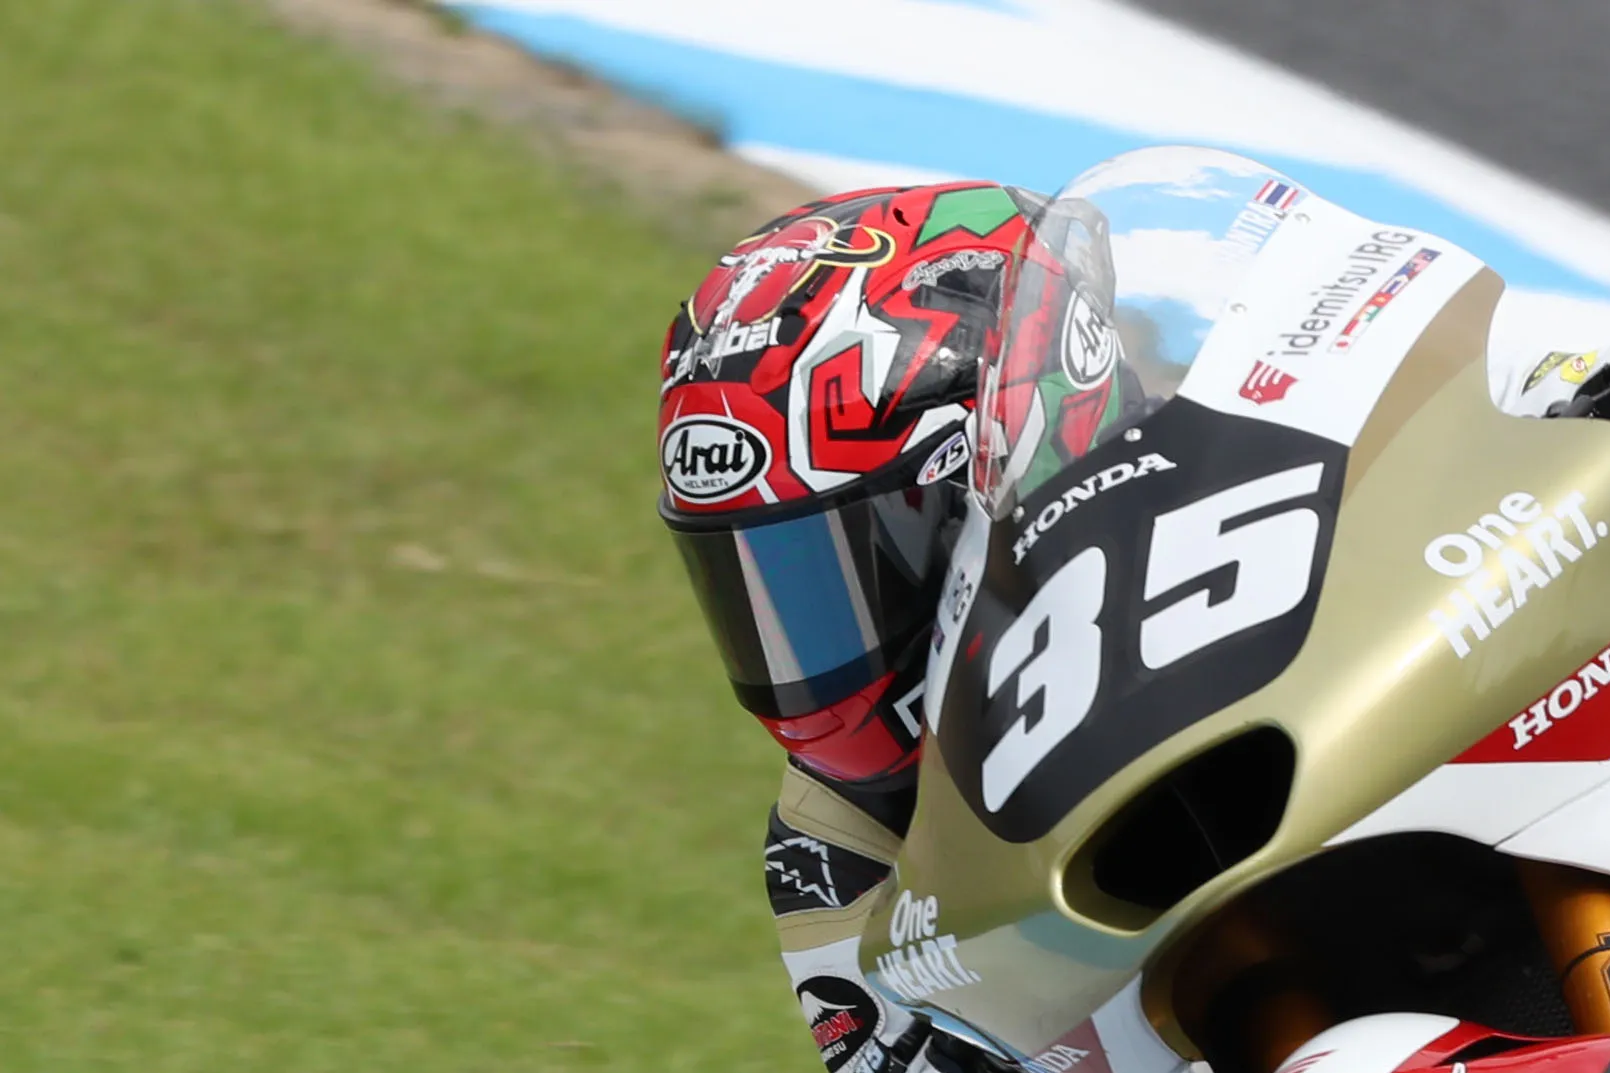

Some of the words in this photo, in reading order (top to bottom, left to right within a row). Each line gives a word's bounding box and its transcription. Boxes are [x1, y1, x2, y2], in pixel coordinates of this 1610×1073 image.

[1267, 262, 1375, 357] idemitsu
[665, 429, 749, 476] Arai
[1012, 452, 1178, 565] HONDA
[1423, 490, 1541, 580] One
[1430, 490, 1609, 660] HEART.
[982, 461, 1325, 813] 35
[890, 889, 939, 948] One
[876, 934, 982, 1002] HEART.
